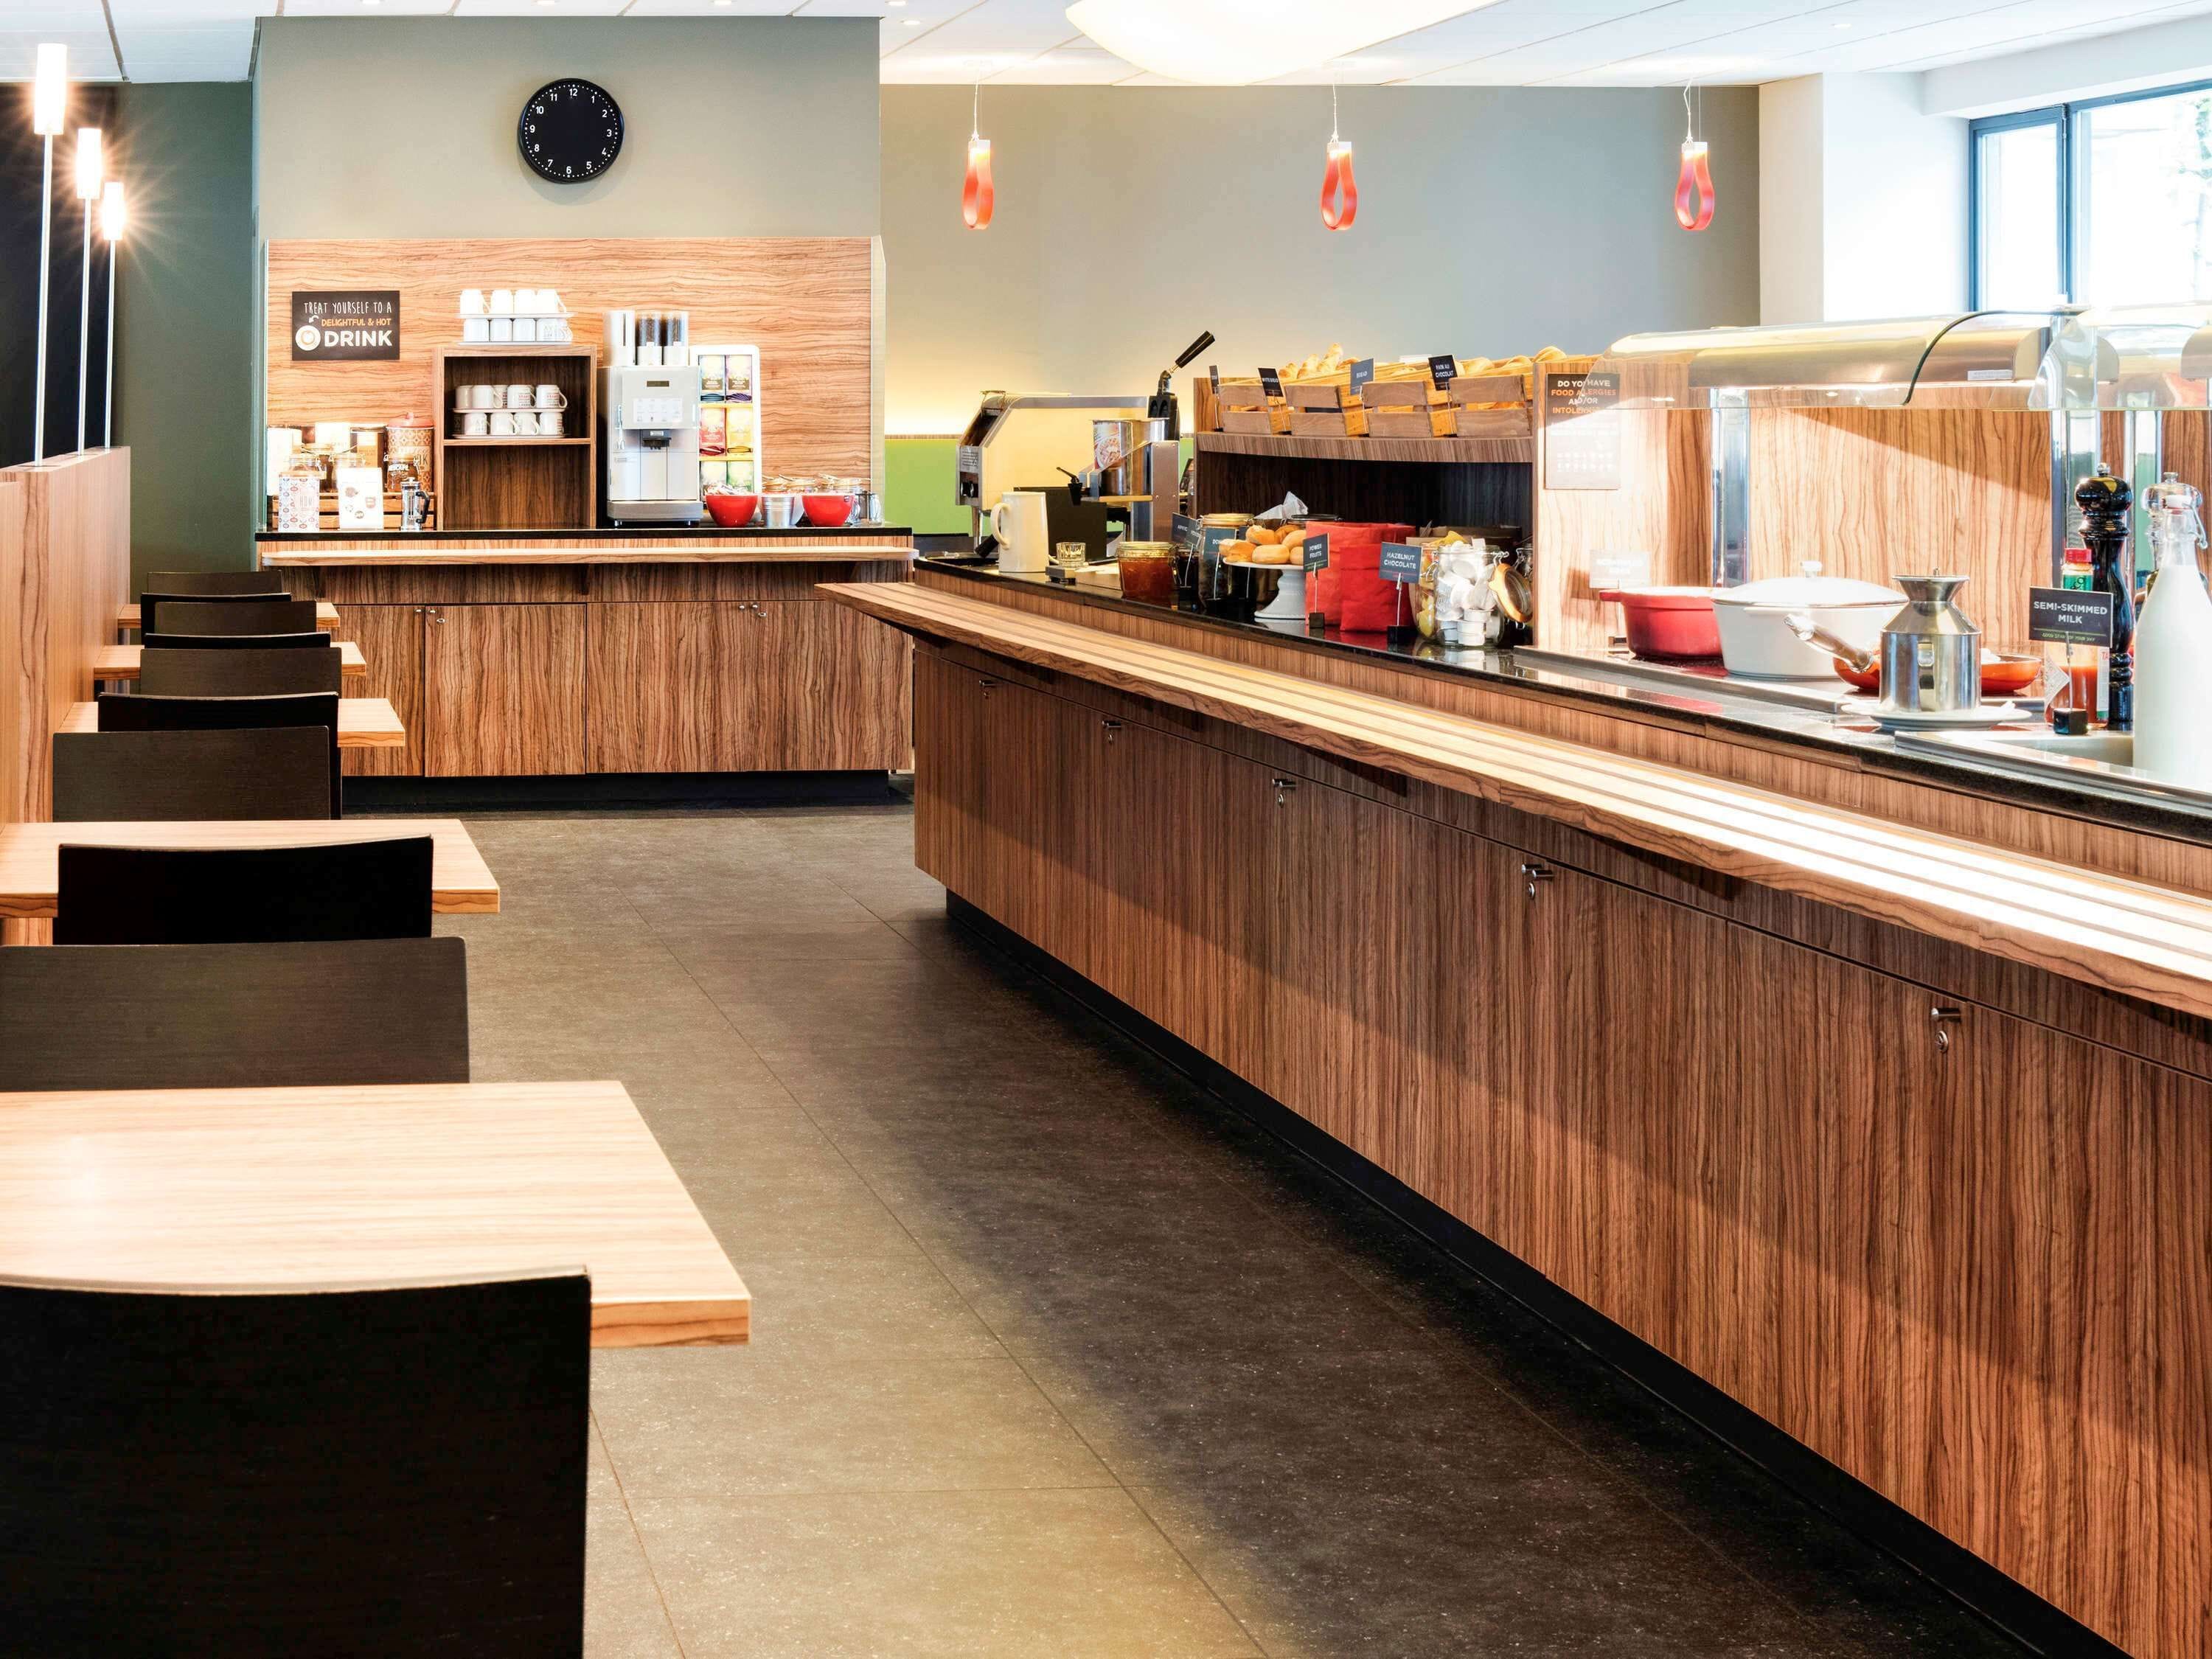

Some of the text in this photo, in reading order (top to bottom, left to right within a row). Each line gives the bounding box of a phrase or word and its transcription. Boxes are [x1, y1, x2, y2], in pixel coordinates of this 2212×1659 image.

[569, 88, 578, 97] 12
[535, 106, 544, 114] 10
[602, 110, 608, 118] 2
[529, 125, 535, 133] 9
[606, 129, 612, 137] 3
[534, 144, 540, 152] 8
[602, 147, 607, 156] 4
[547, 159, 553, 167] 7
[586, 161, 592, 170] 5
[566, 166, 572, 174] 6
[304, 301, 392, 314] TREAT YOURSELF TO A
[321, 318, 392, 327] DELIGHTFUL & HOT
[324, 330, 392, 347] DRINK
[1587, 379, 1611, 387] HAVE
[1309, 551, 1322, 559] FRUITS
[1386, 552, 1416, 561] HAZELNUT
[1383, 560, 1416, 569] CHOCOLATE
[2034, 602, 2107, 614] SEMI-SKIMMED
[2058, 614, 2083, 624] MILK
